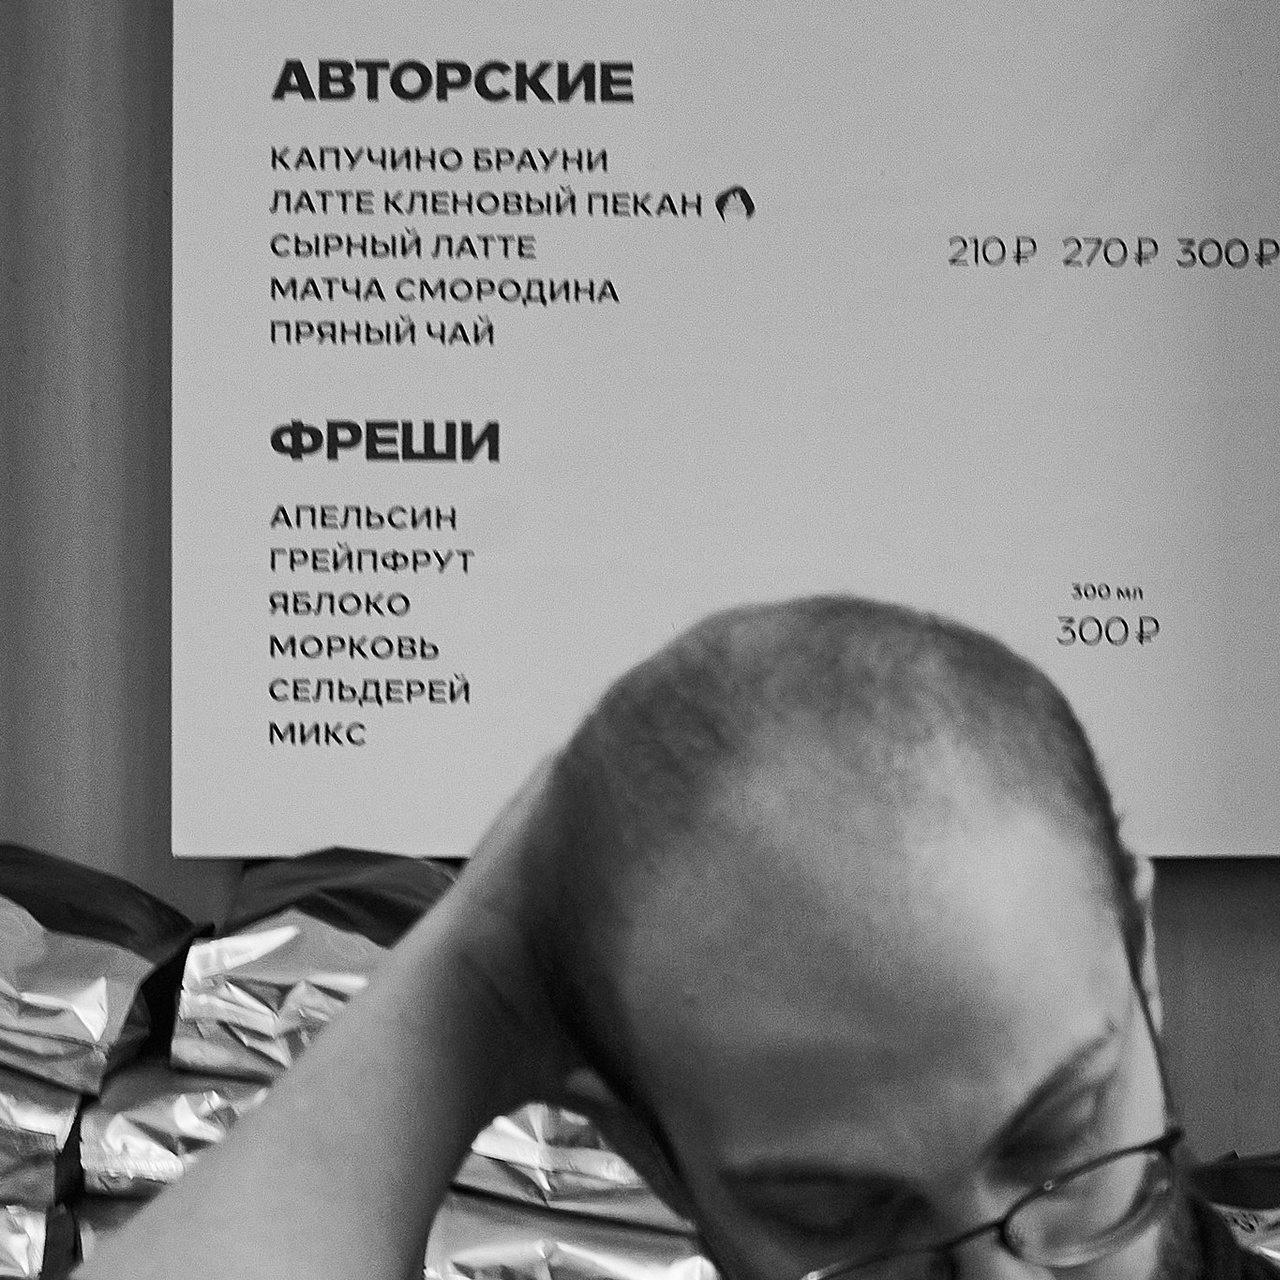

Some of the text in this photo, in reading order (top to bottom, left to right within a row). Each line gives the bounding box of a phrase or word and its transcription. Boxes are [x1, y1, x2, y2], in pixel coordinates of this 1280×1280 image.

[270, 58, 635, 105] АВТОРСКИЕ
[270, 146, 609, 173] КАПУЧИНО БРАУНИ
[269, 185, 703, 218] ЛАТТЕ КЛЕНОВЫЙ ПЕКАН
[269, 226, 535, 260] СЫРНЫЙ ЛАТТЕ
[269, 276, 621, 308] МАТЧА СМОРОДИНА
[269, 314, 495, 346] ПРЯНЫЙ ЧАЙ
[269, 419, 501, 464] ФРЕШИ
[269, 504, 458, 531] АПЕЛЬСИН
[269, 542, 475, 574] ГРЕЙПФРУТ
[268, 591, 412, 617] ЯБЛОКО
[1072, 583, 1112, 600] 300
[268, 634, 440, 661] МОРКОВЬ
[267, 673, 472, 707] СЕЛЬДЕРЕЙ
[267, 721, 366, 747] МИКС
